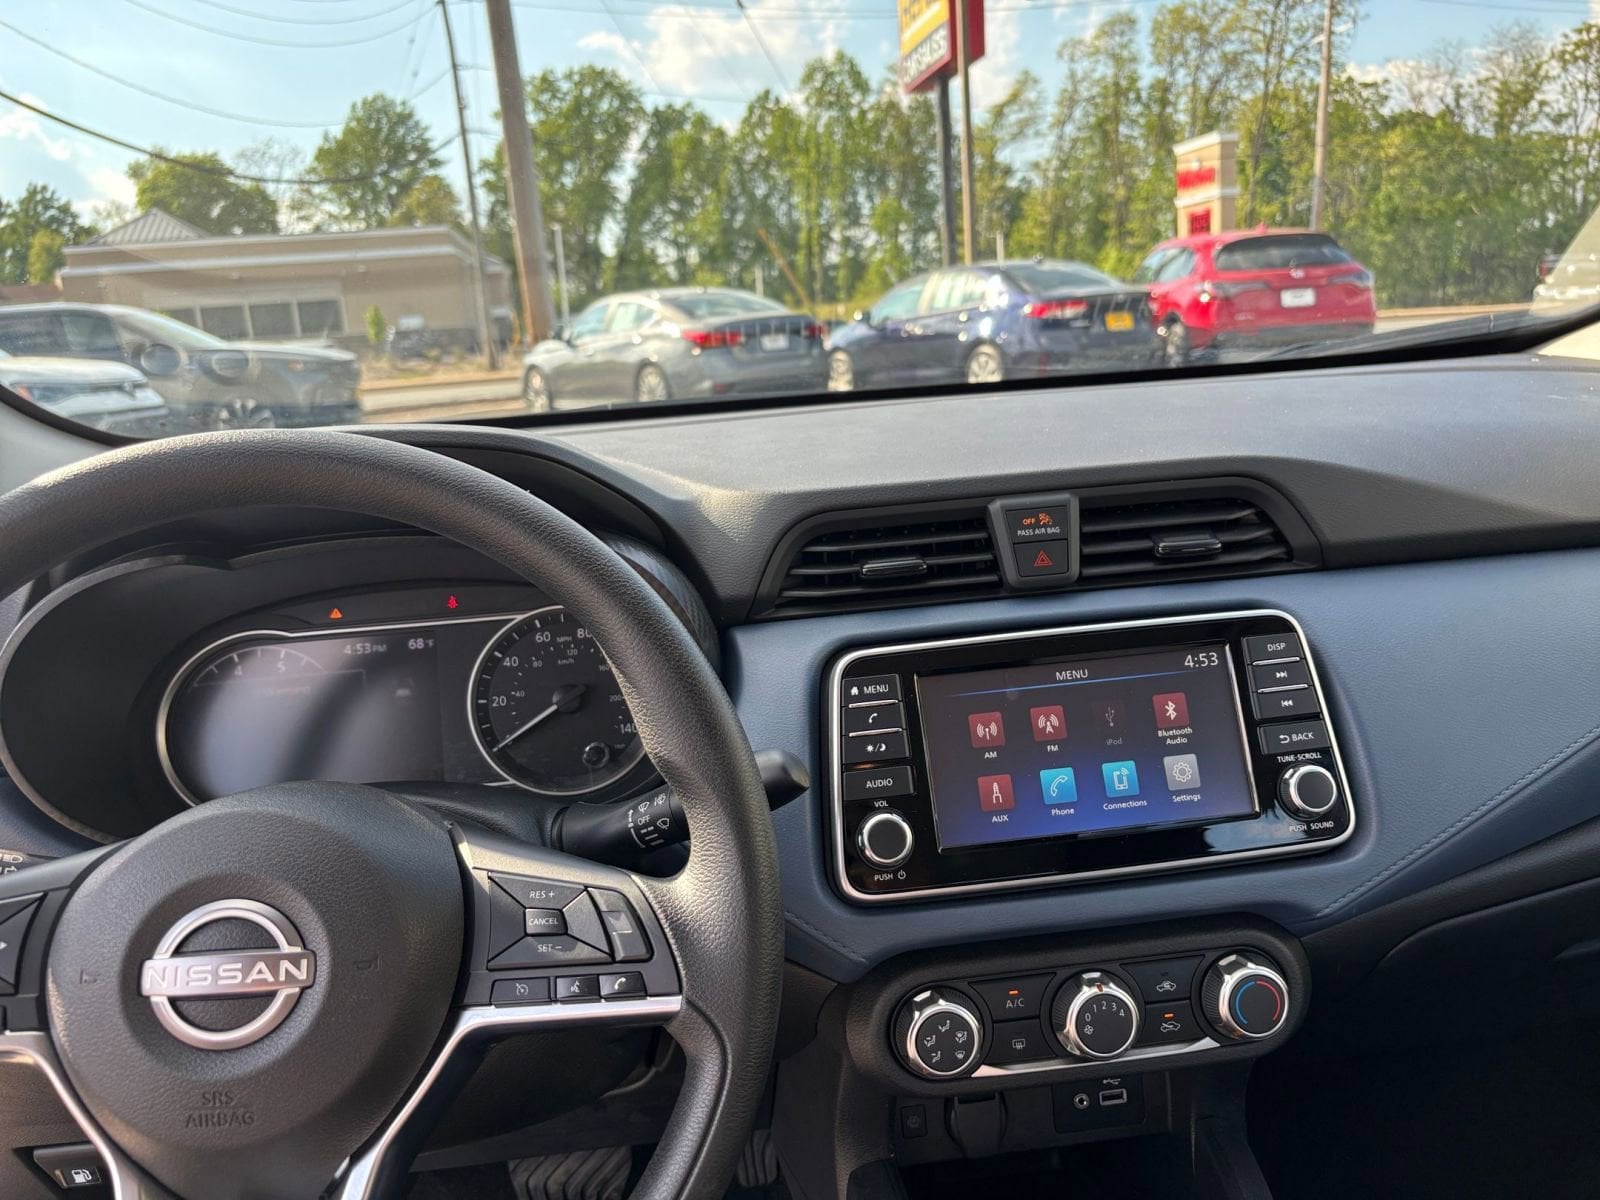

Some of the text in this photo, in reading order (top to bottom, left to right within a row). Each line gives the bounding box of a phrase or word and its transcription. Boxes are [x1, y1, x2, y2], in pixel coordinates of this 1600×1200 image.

[1022, 518, 1036, 526] OFF
[1017, 526, 1060, 537] PASS AIR BAG
[535, 631, 551, 643] 60
[1267, 642, 1286, 652] DISP
[503, 656, 519, 667] 40
[1184, 652, 1219, 668] 4:53
[1055, 669, 1088, 680] MENU
[515, 690, 525, 698] 40
[863, 684, 889, 695] MENU
[492, 695, 507, 707] 20
[1158, 727, 1193, 737] Bluetooth
[1292, 731, 1315, 742] BACK
[1106, 737, 1123, 746] iPod
[1166, 736, 1188, 745] Audio
[1047, 744, 1059, 752] FM
[984, 751, 997, 759] AM
[866, 778, 893, 789] AUDIO
[1172, 793, 1201, 803] Settings
[874, 800, 888, 808] VOL
[1103, 800, 1148, 811] Connections
[1051, 807, 1075, 816] Phone
[637, 814, 651, 826] OFF
[991, 815, 1009, 824] AUX
[1289, 820, 1334, 832] PUSH SOUND
[874, 872, 894, 882] PUSH
[529, 890, 546, 899] RES
[528, 917, 559, 926] CANCEL
[537, 944, 552, 953] SET
[146, 959, 308, 989] NISSAN
[1005, 998, 1024, 1009] A/C
[1092, 1004, 1097, 1013] 1
[1101, 1001, 1107, 1010] 2
[1111, 1002, 1117, 1011] 3
[1085, 1012, 1091, 1022] 0
[1119, 1008, 1125, 1016] 4
[201, 1091, 234, 1105] SRS
[186, 1112, 255, 1129] AIRBAG
